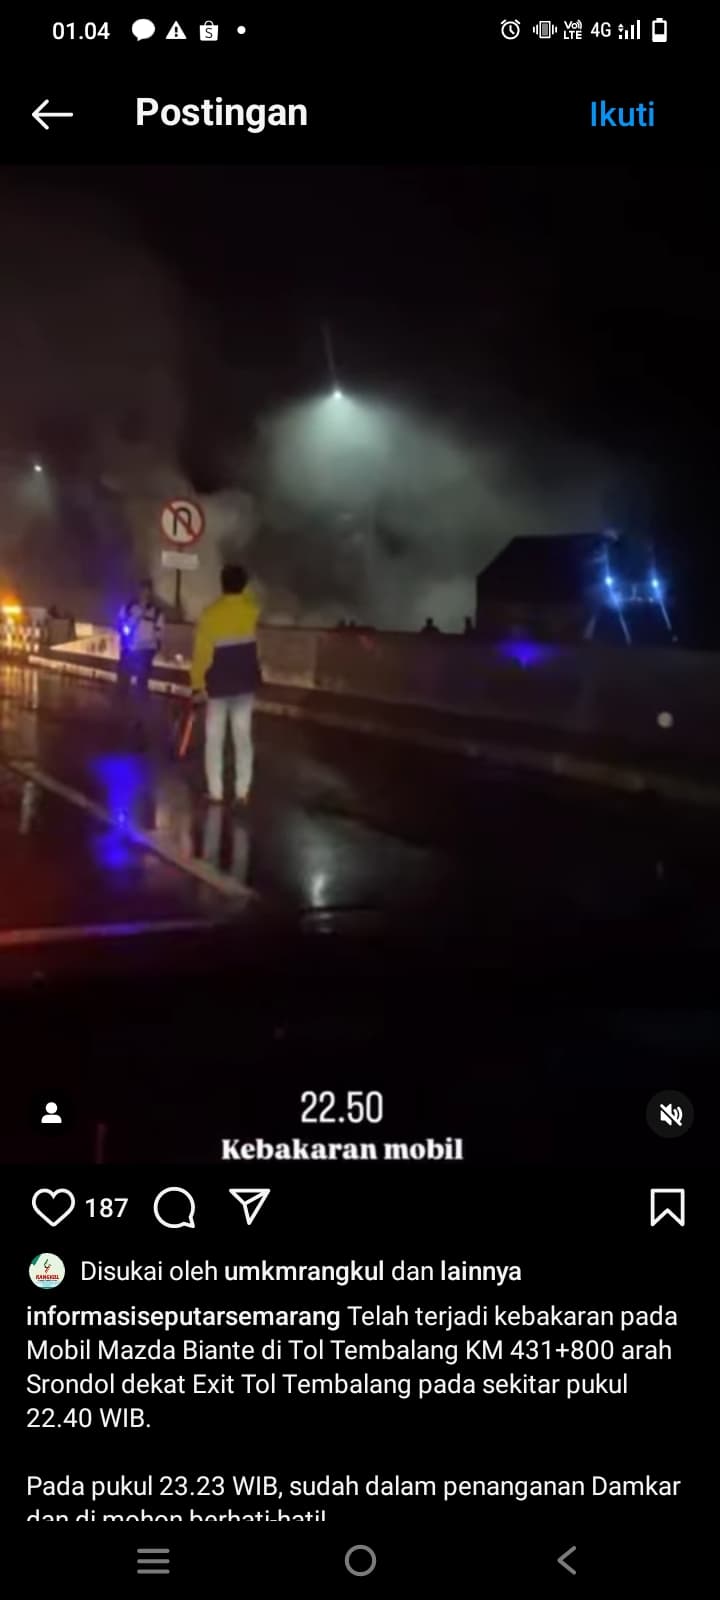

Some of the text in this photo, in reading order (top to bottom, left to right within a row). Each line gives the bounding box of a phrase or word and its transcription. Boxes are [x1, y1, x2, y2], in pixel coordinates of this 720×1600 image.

[52, 21, 111, 40] 01.04
[563, 30, 583, 40] LTE
[590, 21, 612, 38] 4G
[136, 96, 308, 134] Postingan
[591, 99, 655, 127] Ikuti
[85, 1197, 129, 1218] 187
[81, 1259, 522, 1287] Disukai oleh umkmrangkul dan lainnya
[27, 1304, 678, 1332] informasiseputarsemarang Telah terjadi kebakaran pada
[27, 1338, 672, 1366] Mobil Mazda Biante di Tol Tembalang KM 431+800 arah
[26, 1372, 628, 1400] Srondol dekat Exit Tol Tembalang pada sekitar pukul
[26, 1407, 151, 1428] 22.40 WIB.
[27, 1474, 682, 1502] Pada pukul 23.23 WIB, sudah dalam penanganan Damkar
